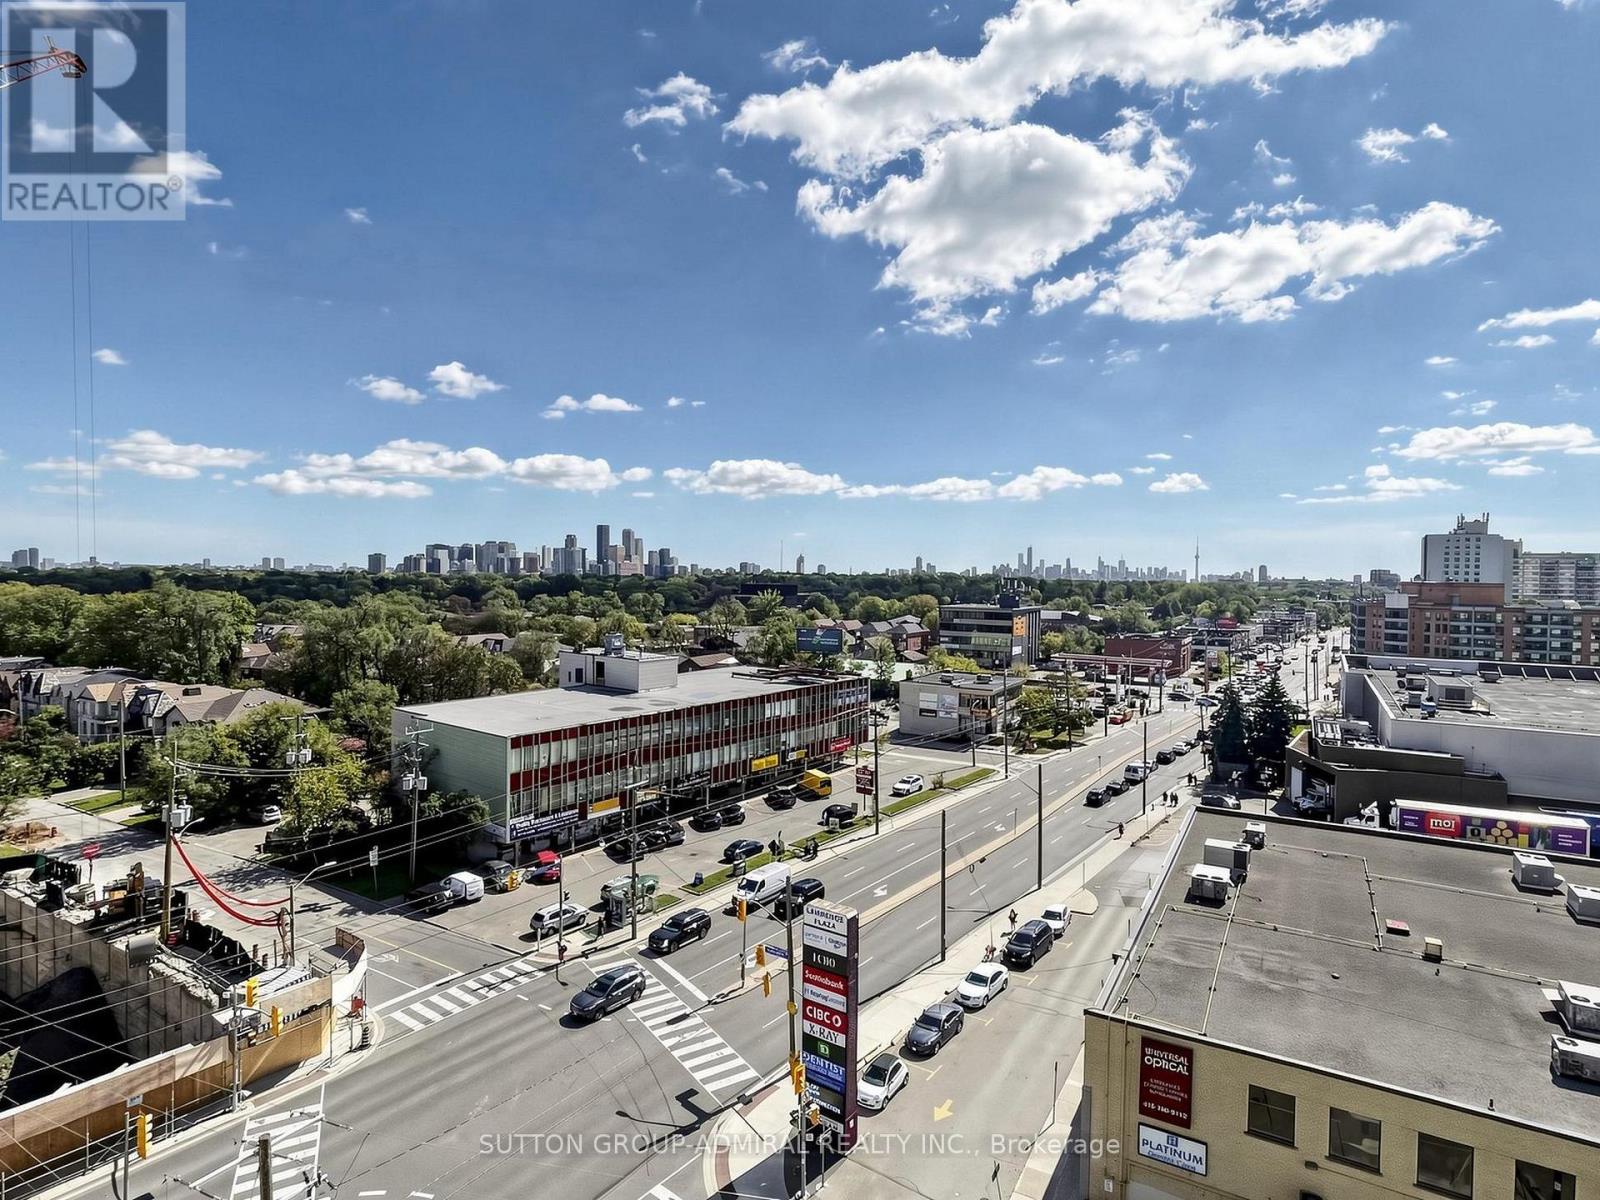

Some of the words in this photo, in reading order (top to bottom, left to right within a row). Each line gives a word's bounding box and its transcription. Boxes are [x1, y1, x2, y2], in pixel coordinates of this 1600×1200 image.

[802, 1051, 846, 1076] DENTIST
[1144, 1056, 1189, 1075] OPTICAL
[1145, 1047, 1189, 1065] UNIVERSAL
[1142, 1138, 1203, 1165] PLATINUM
